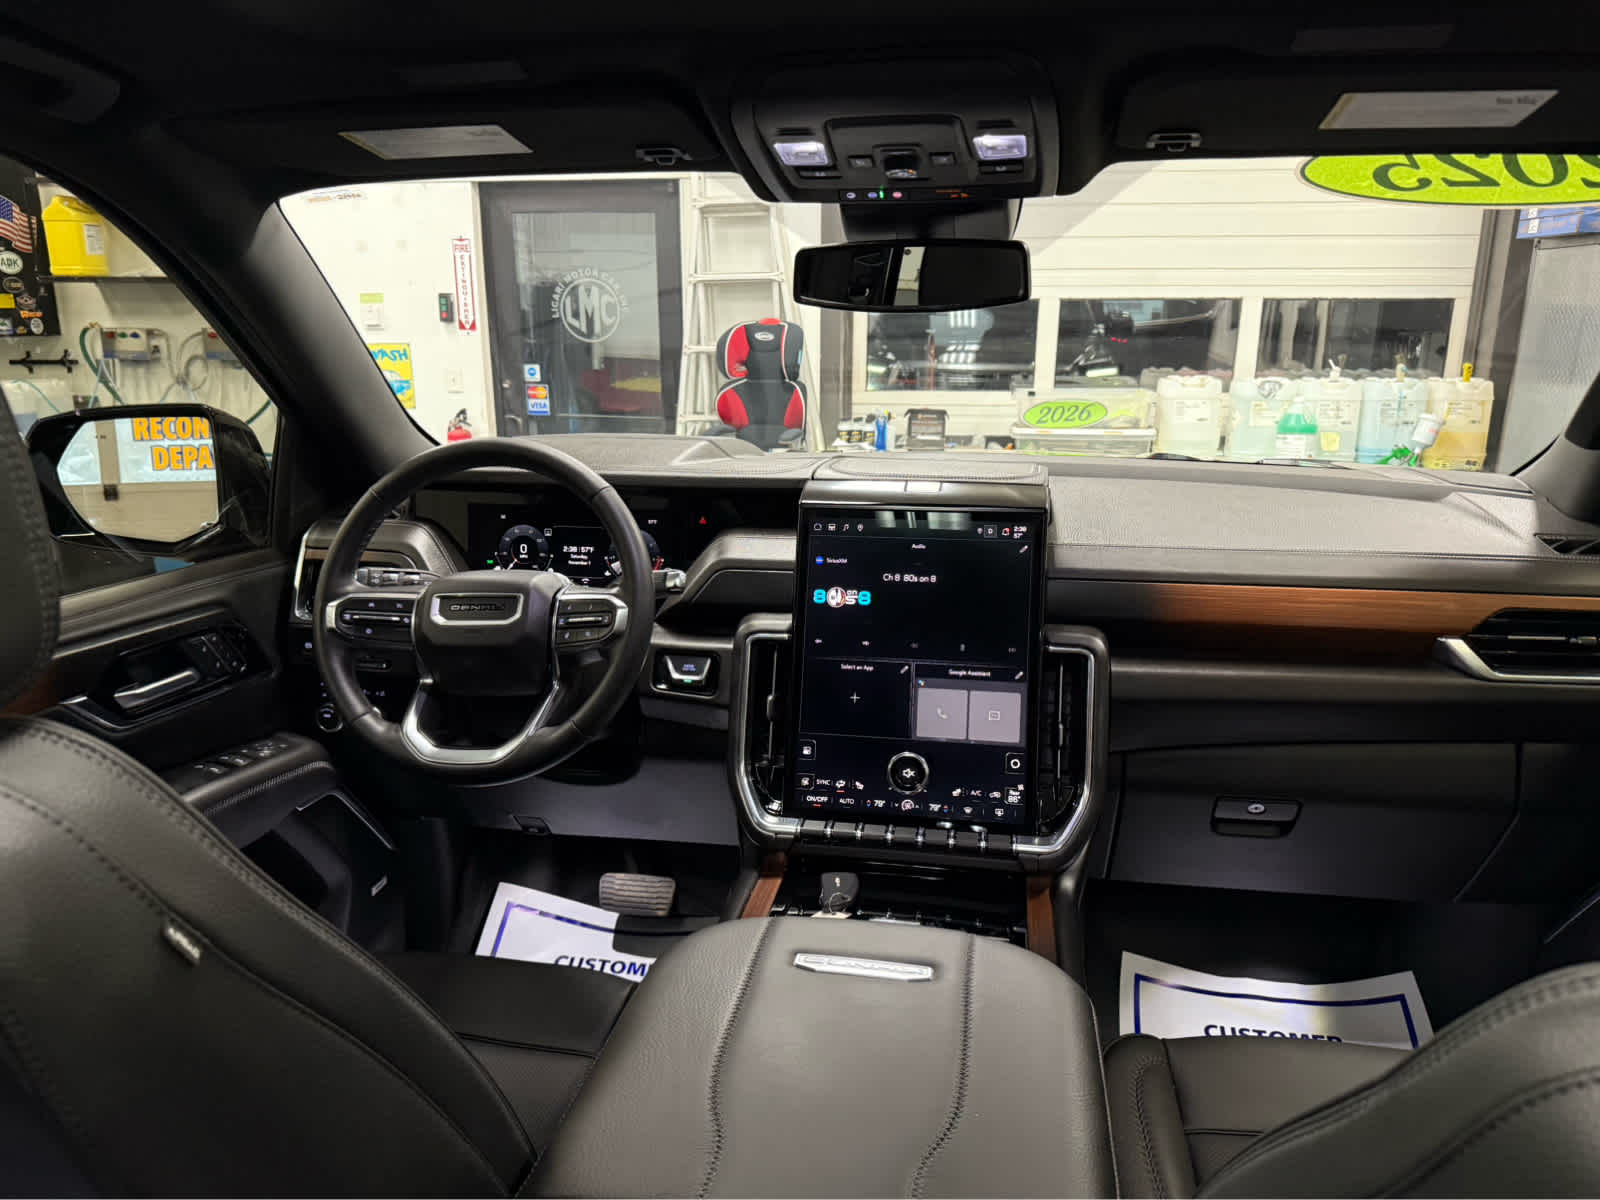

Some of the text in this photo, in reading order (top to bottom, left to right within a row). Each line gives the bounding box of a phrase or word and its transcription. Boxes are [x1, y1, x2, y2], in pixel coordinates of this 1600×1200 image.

[565, 285, 618, 335] LMC
[530, 401, 549, 409] VISA
[1035, 402, 1096, 424] 2026
[131, 416, 211, 441] RECON
[151, 443, 216, 471] DEPA
[519, 543, 528, 554] 0
[882, 573, 937, 583] Ch 8 80s on 8
[816, 778, 831, 786] SYNC
[806, 795, 829, 803] ON/OFF
[839, 797, 855, 805] AUTO
